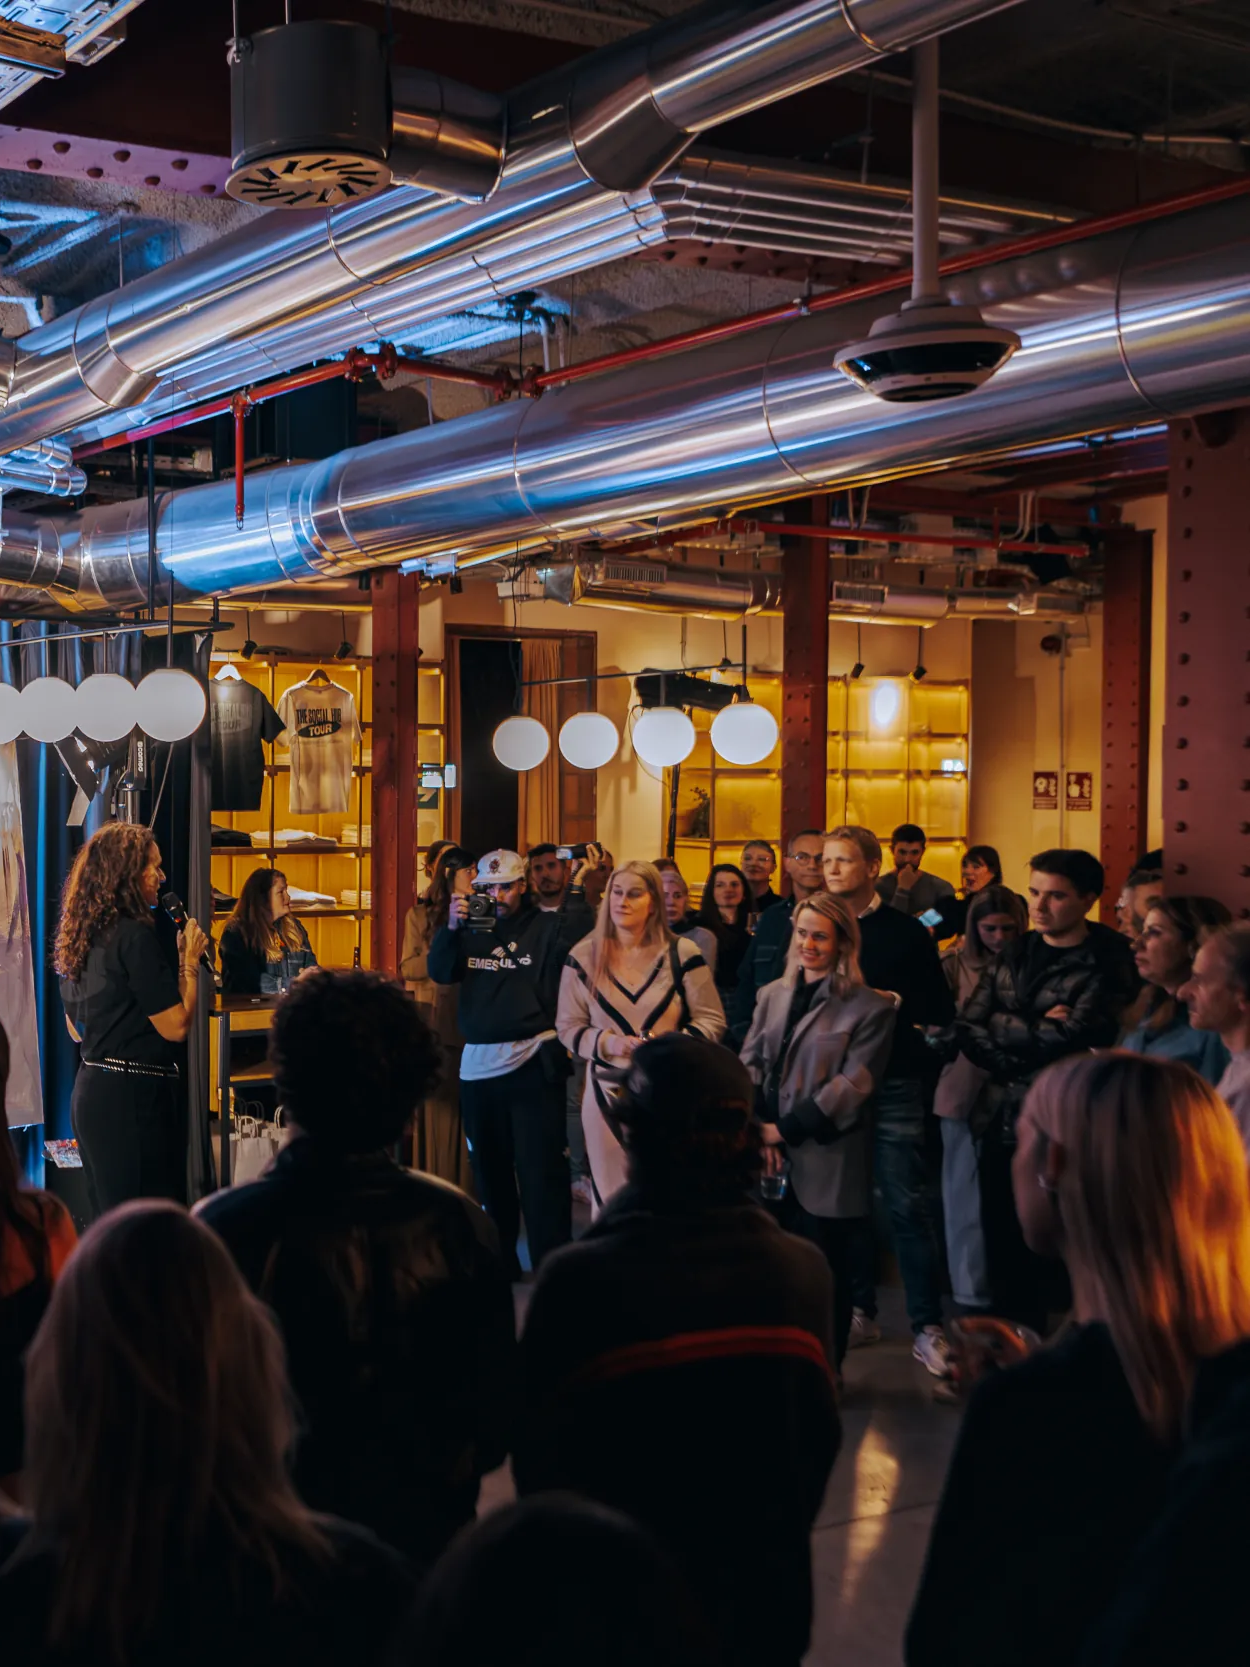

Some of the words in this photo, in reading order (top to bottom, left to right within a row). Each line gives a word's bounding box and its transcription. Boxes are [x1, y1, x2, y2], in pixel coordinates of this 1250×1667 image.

[296, 708, 307, 724] THE
[308, 707, 328, 724] SOCIAL
[309, 723, 333, 737] TOUR
